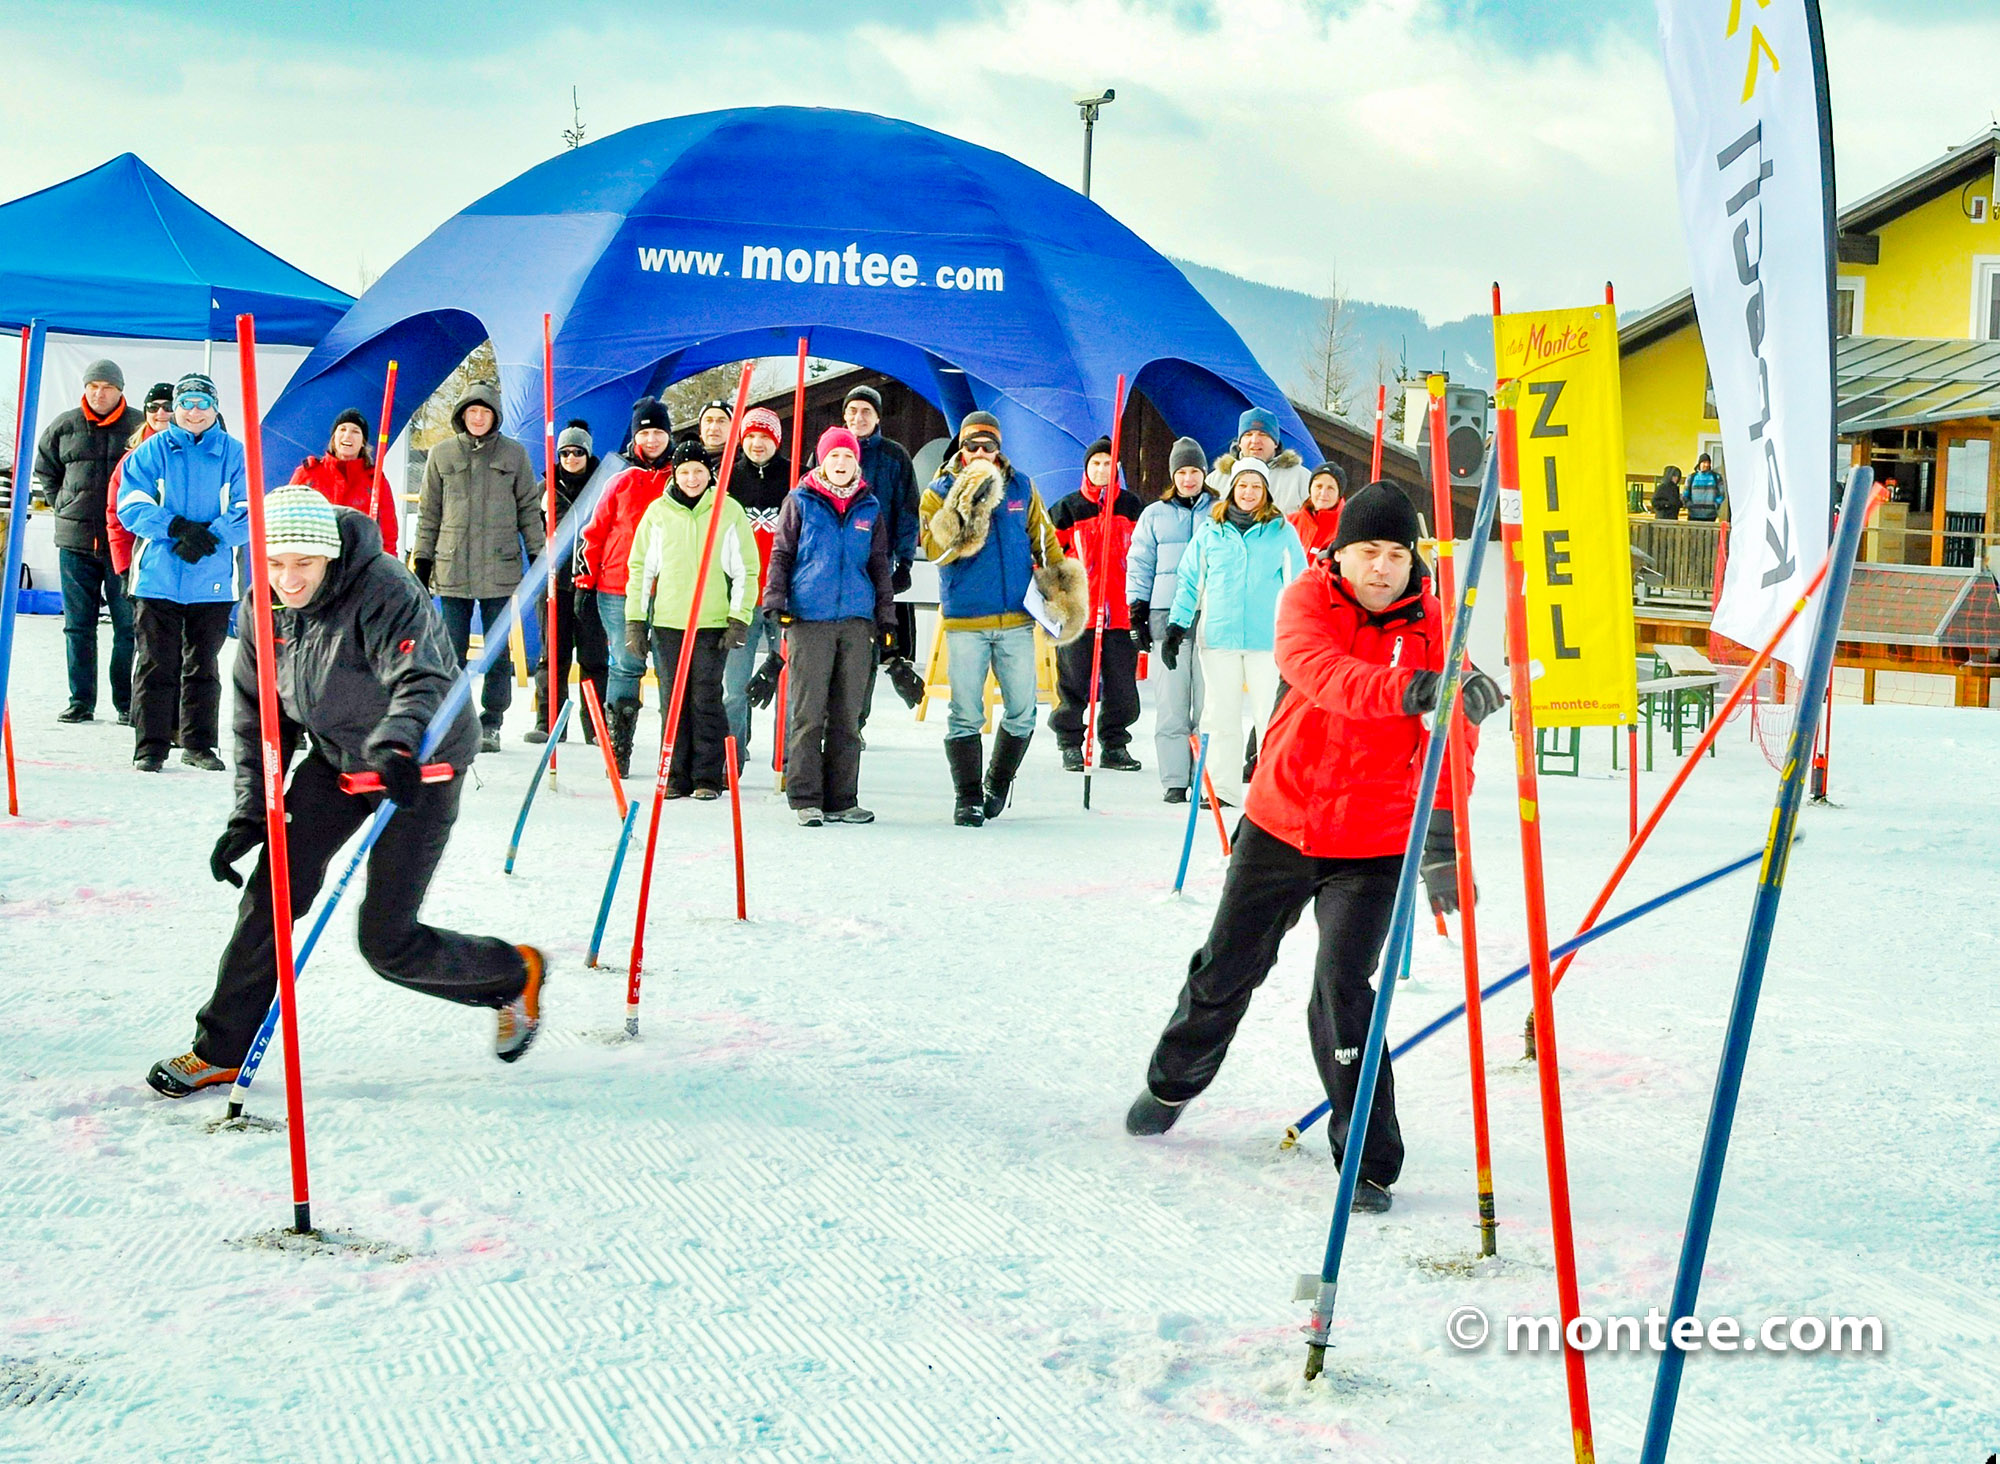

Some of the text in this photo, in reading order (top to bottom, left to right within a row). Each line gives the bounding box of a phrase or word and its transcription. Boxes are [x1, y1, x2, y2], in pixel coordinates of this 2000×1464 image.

[638, 247, 730, 276] www.
[1501, 498, 1521, 519] 23
[1528, 380, 1580, 659] ZIEL
